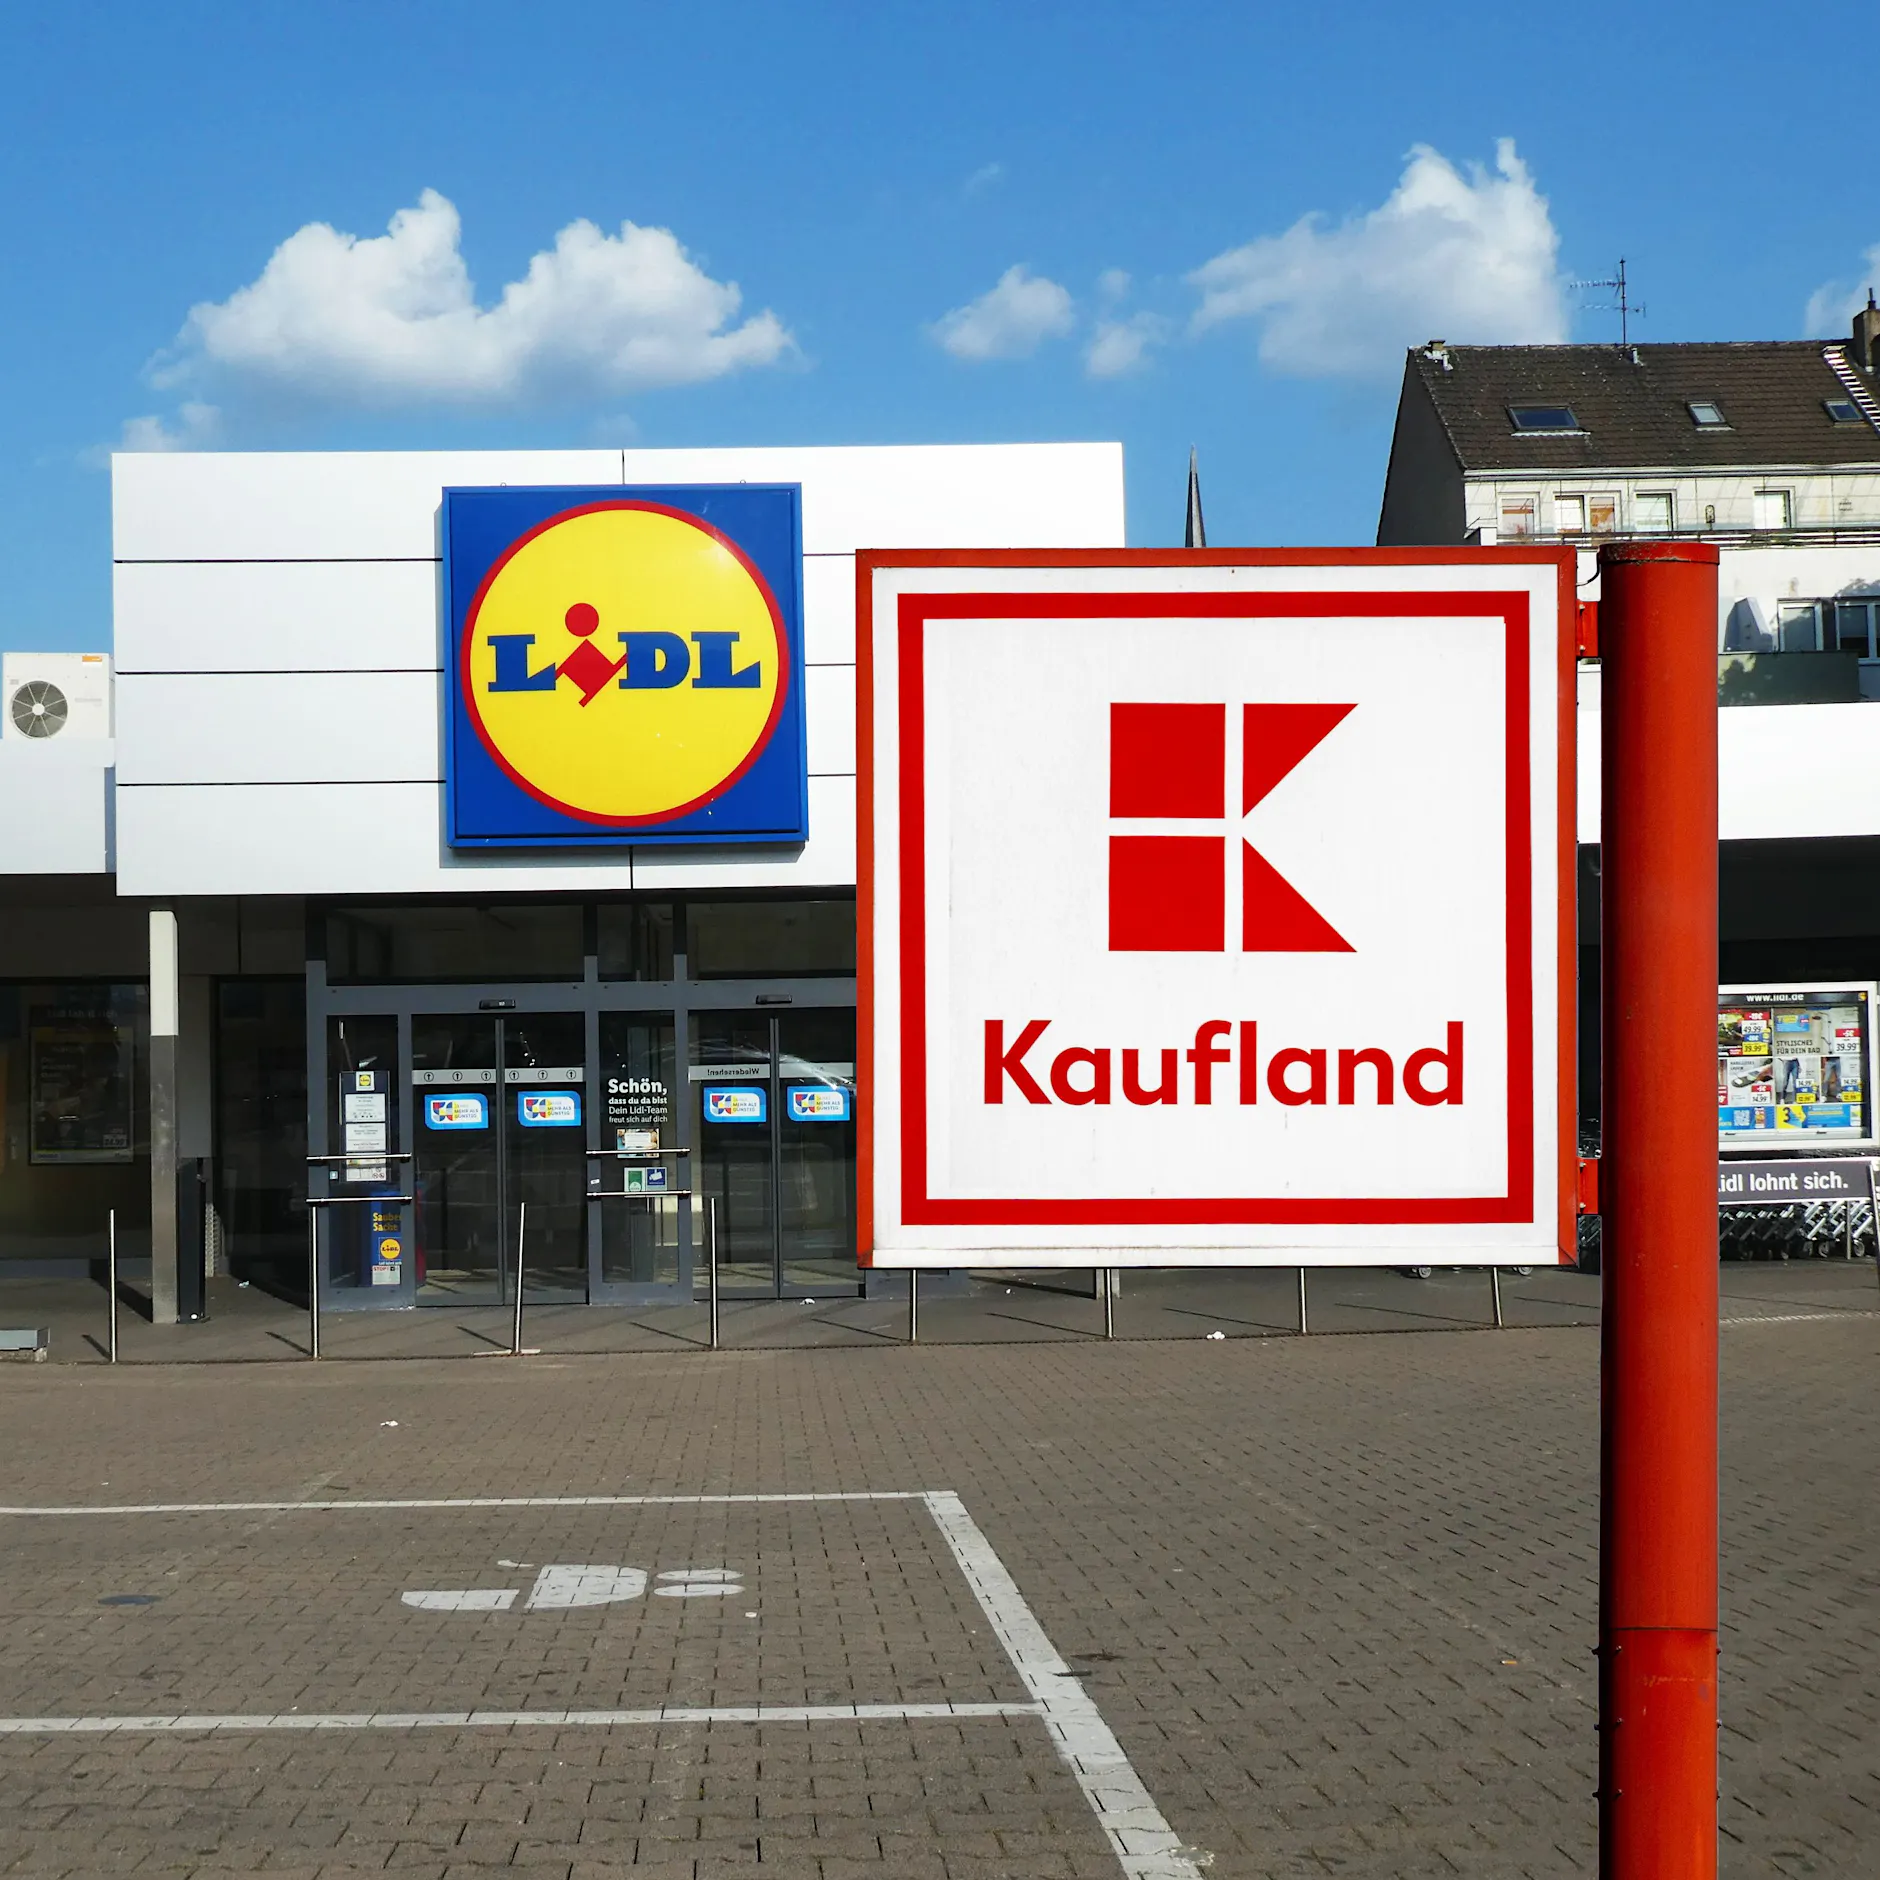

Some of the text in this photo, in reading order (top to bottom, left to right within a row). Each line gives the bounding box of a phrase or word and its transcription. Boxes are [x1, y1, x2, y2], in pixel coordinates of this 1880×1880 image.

[1836, 1043, 1857, 1051] 39.99
[984, 1019, 1463, 1106] Kaufland
[608, 1077, 668, 1096] Schön,
[608, 1096, 668, 1105] dass du da bist
[608, 1106, 668, 1115] Dein Lidl-Team
[1718, 1171, 1849, 1192] idl lohnt sich.
